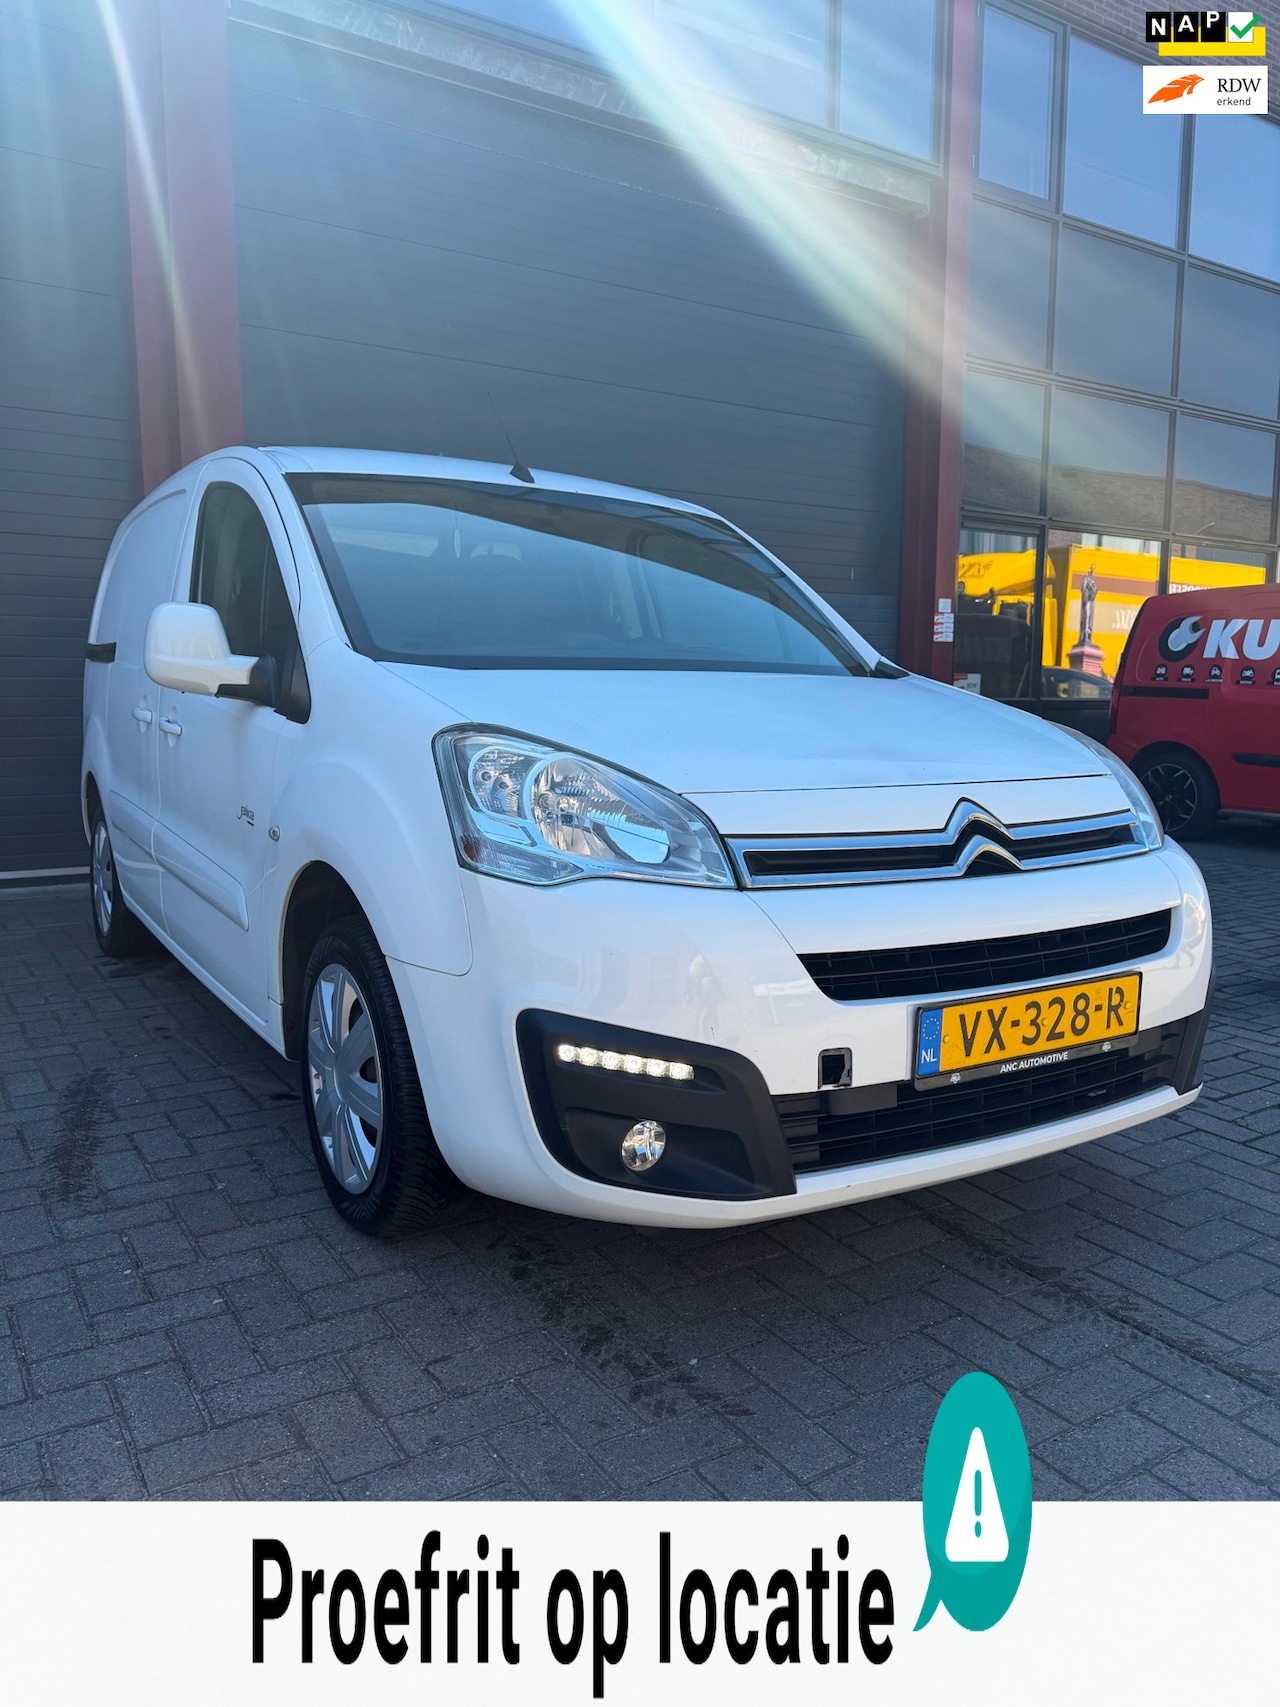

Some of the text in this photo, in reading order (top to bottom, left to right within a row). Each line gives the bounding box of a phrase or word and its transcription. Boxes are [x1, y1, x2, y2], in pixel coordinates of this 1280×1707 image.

[959, 986, 1125, 1057] VX-328-R
[921, 1048, 937, 1064] NL
[1000, 1051, 1069, 1074] ANC AUTOMOTIVE
